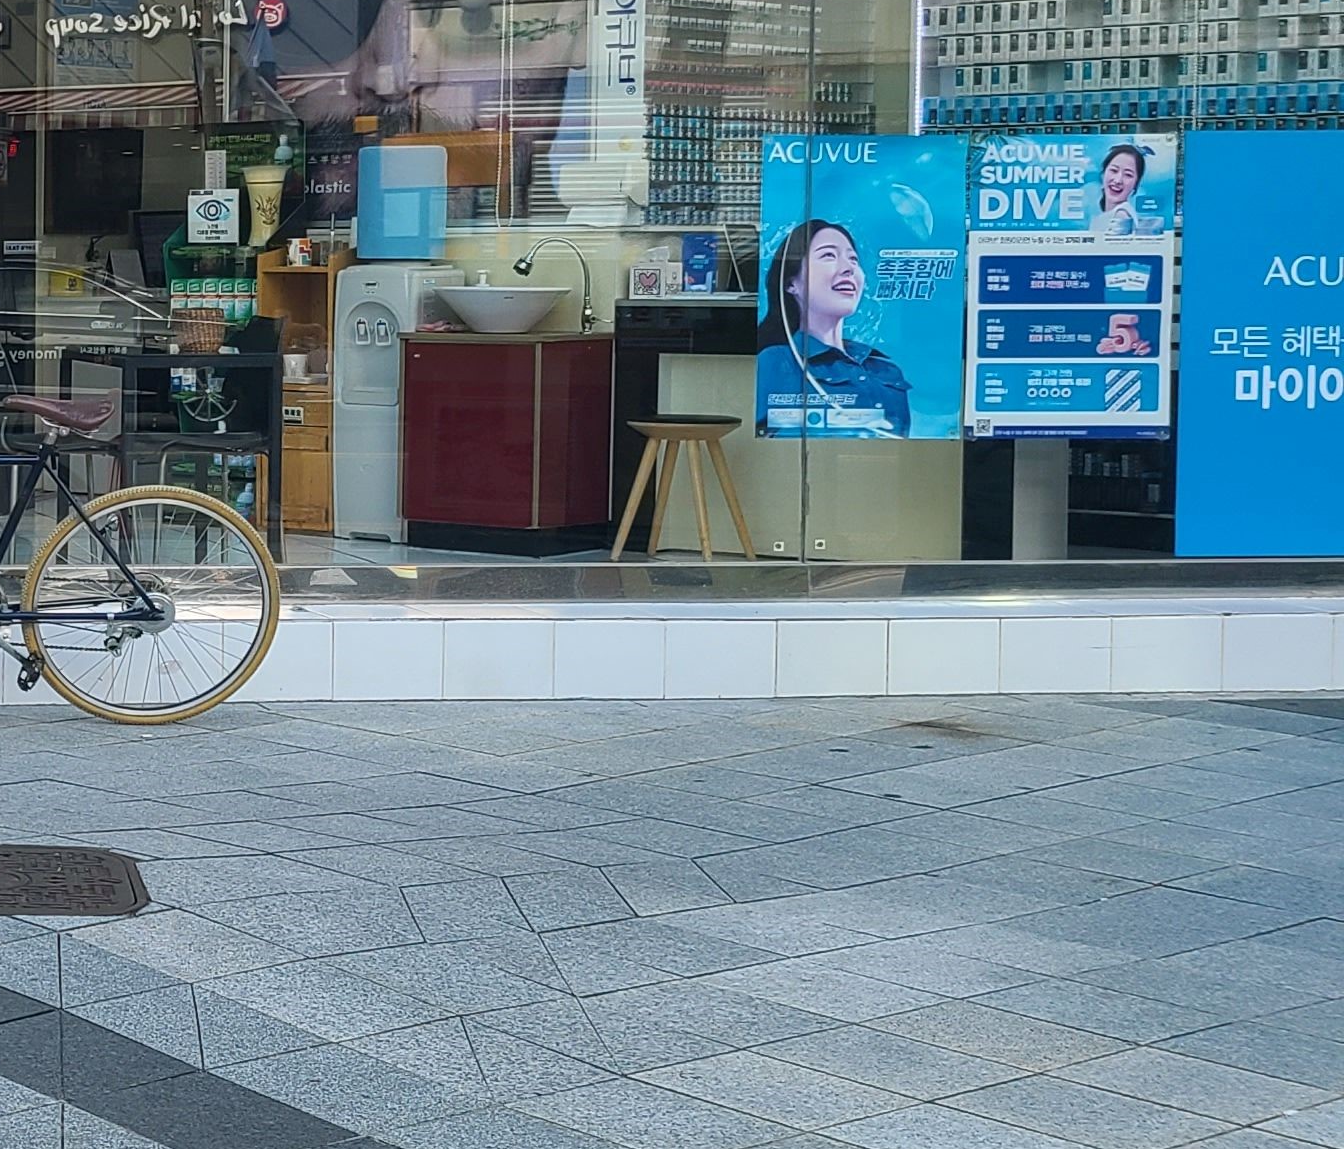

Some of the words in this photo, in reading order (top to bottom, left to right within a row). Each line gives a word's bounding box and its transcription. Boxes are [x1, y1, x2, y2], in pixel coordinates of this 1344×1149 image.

[767, 141, 879, 164] ACUVUE
[981, 144, 1086, 164] ACUVUE
[979, 165, 1085, 184] SUMMER
[979, 188, 1085, 220] DIVE
[876, 258, 955, 279] 촉촉함에
[875, 279, 936, 301] 빠지다
[1209, 325, 1272, 358] 모든
[1281, 325, 1344, 358] 혜택
